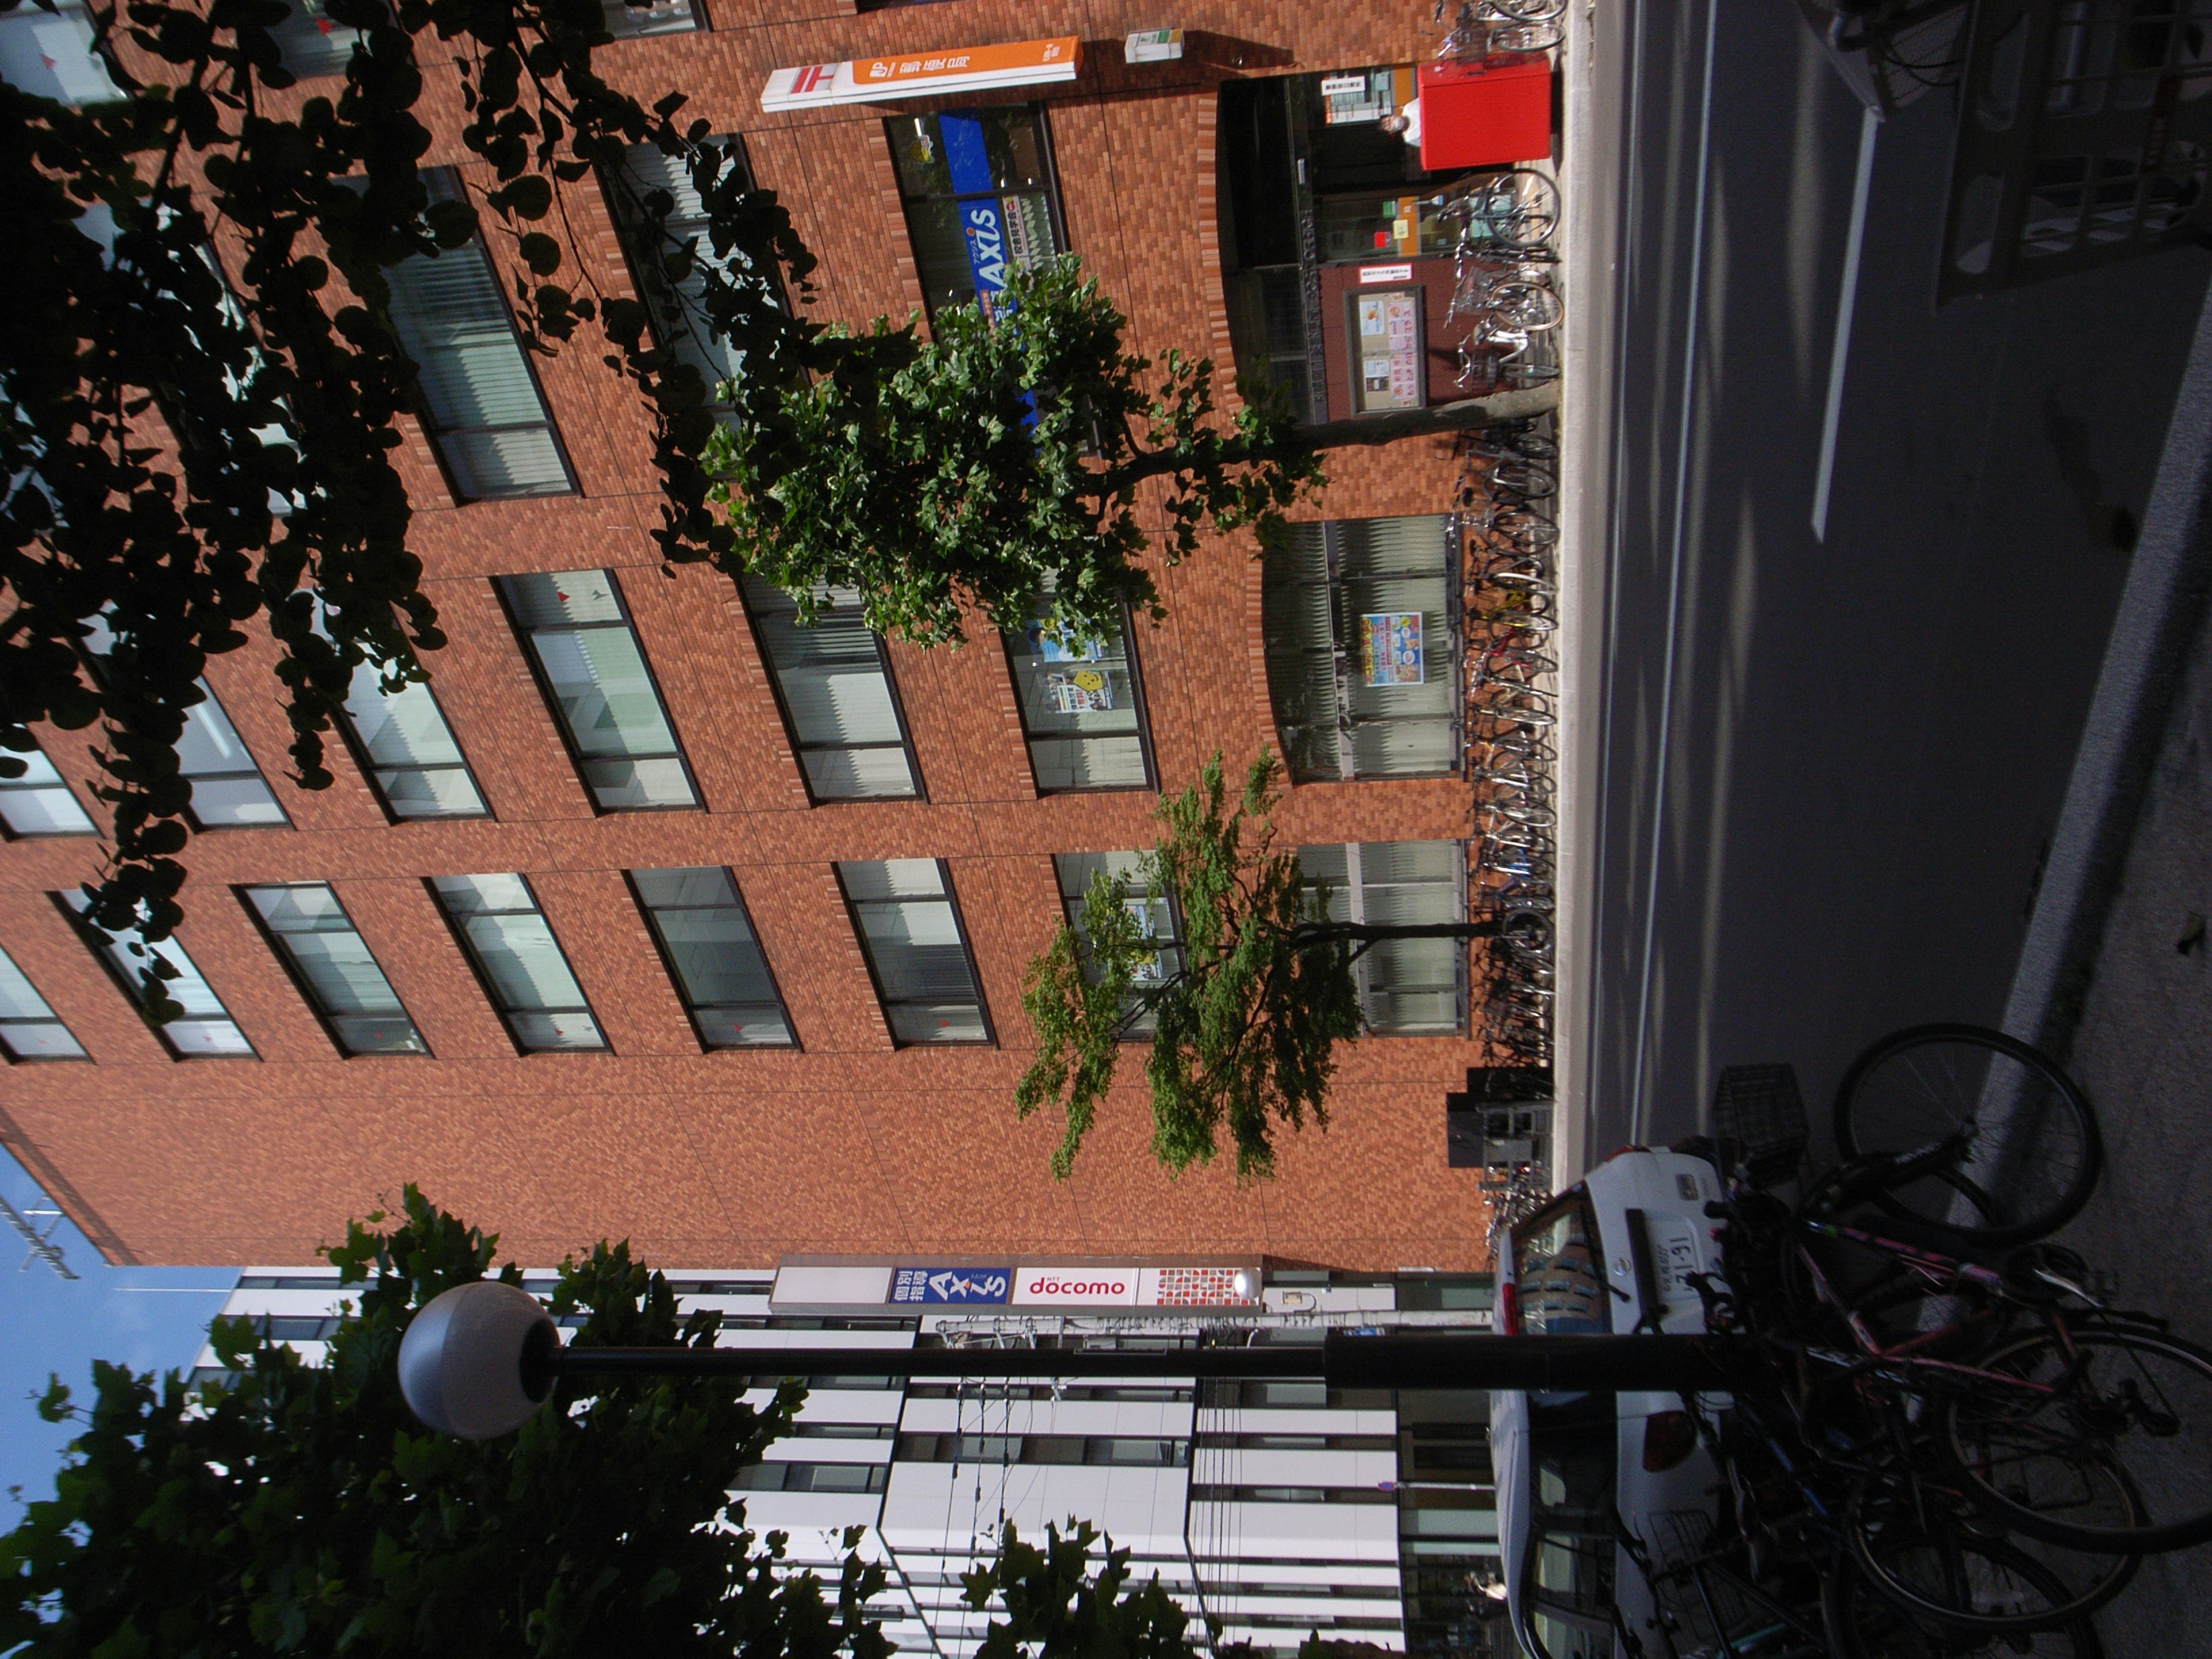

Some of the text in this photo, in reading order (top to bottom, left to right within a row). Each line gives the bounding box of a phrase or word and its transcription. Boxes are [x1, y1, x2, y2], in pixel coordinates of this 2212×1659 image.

[869, 62, 888, 78] JP
[899, 55, 971, 73] 郵便局
[1007, 211, 1024, 255] 校舎見学会
[969, 238, 980, 264] アクシス
[894, 1270, 913, 1301] 個別
[909, 1270, 928, 1301] 指導
[1029, 1277, 1125, 1294] docomo
